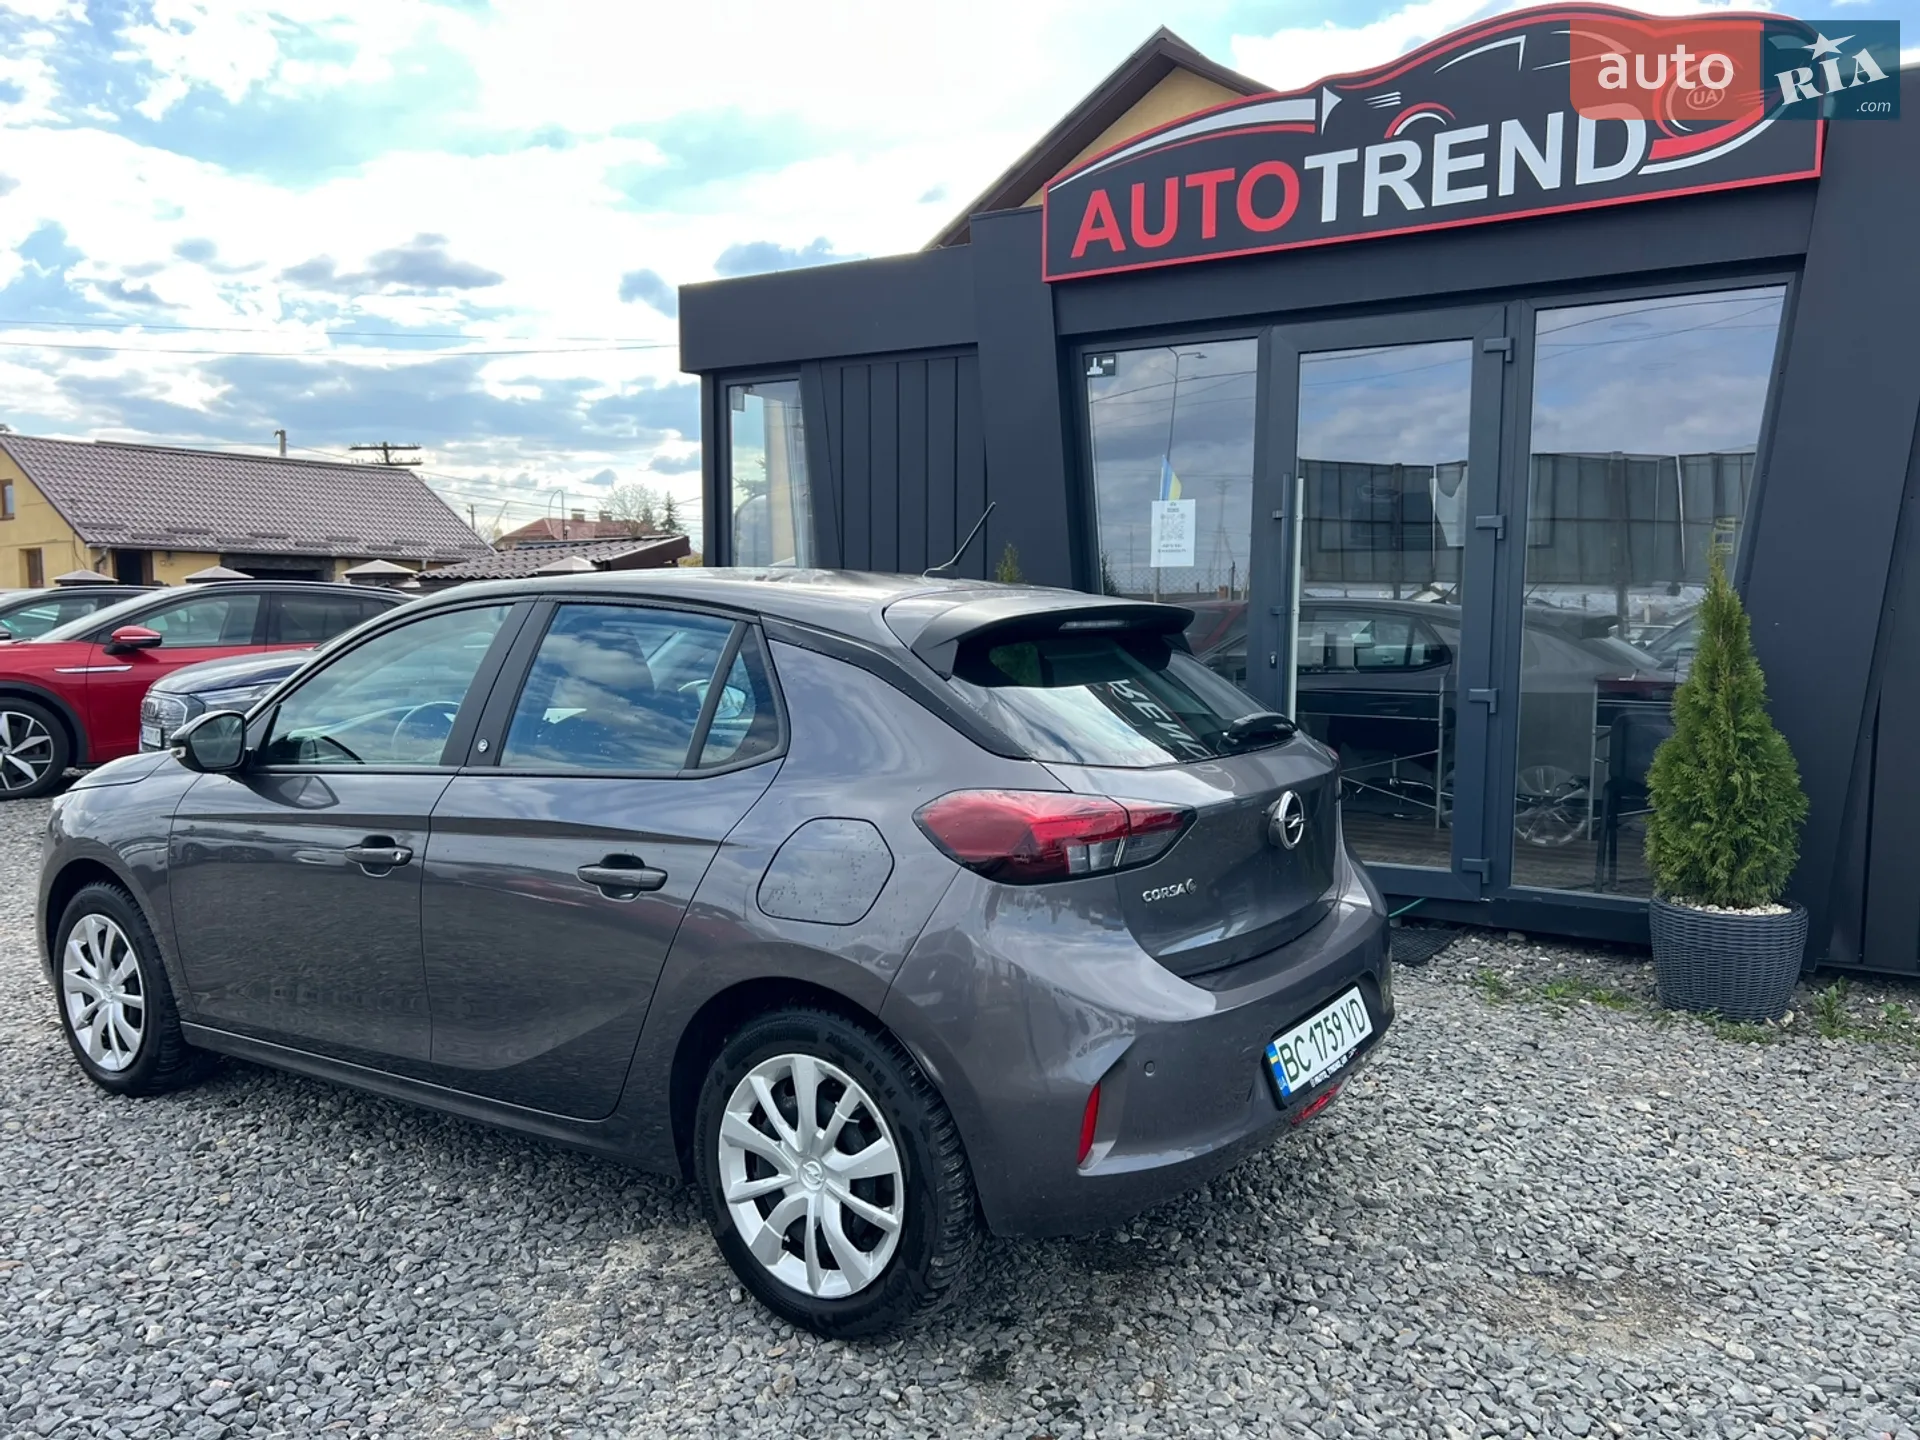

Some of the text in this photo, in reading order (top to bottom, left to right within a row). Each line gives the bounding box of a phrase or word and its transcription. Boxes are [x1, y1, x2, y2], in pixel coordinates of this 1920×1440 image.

[1142, 883, 1187, 902] CORSA
[1279, 1035, 1311, 1083] BC
[1309, 1011, 1345, 1062] 1759
[1340, 998, 1366, 1039] YD
